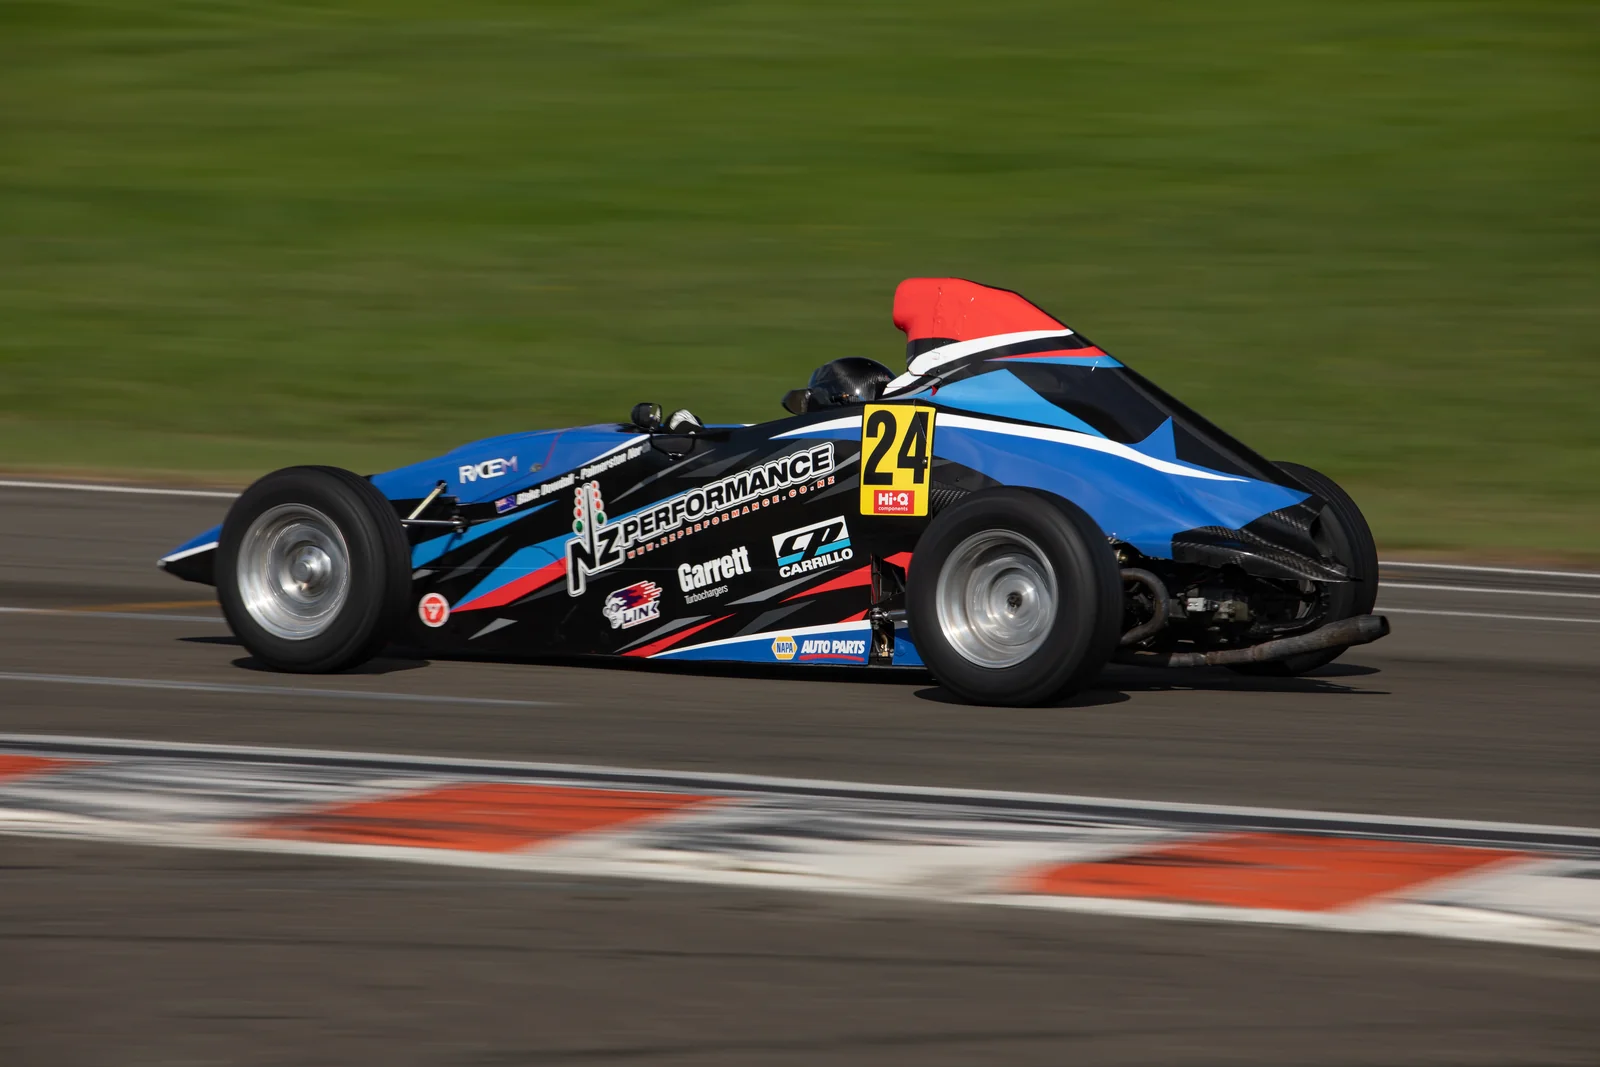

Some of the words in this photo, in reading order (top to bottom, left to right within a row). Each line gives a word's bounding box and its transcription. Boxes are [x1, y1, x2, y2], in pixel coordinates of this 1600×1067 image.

[863, 410, 929, 486] 24
[677, 546, 752, 592] Garrett
[779, 548, 854, 578] CARRILLO
[684, 584, 728, 605] Turbochargers
[623, 602, 658, 624] LINK
[776, 642, 794, 653] NAPA
[801, 640, 831, 654] AUTO
[831, 639, 866, 655] PARTS
